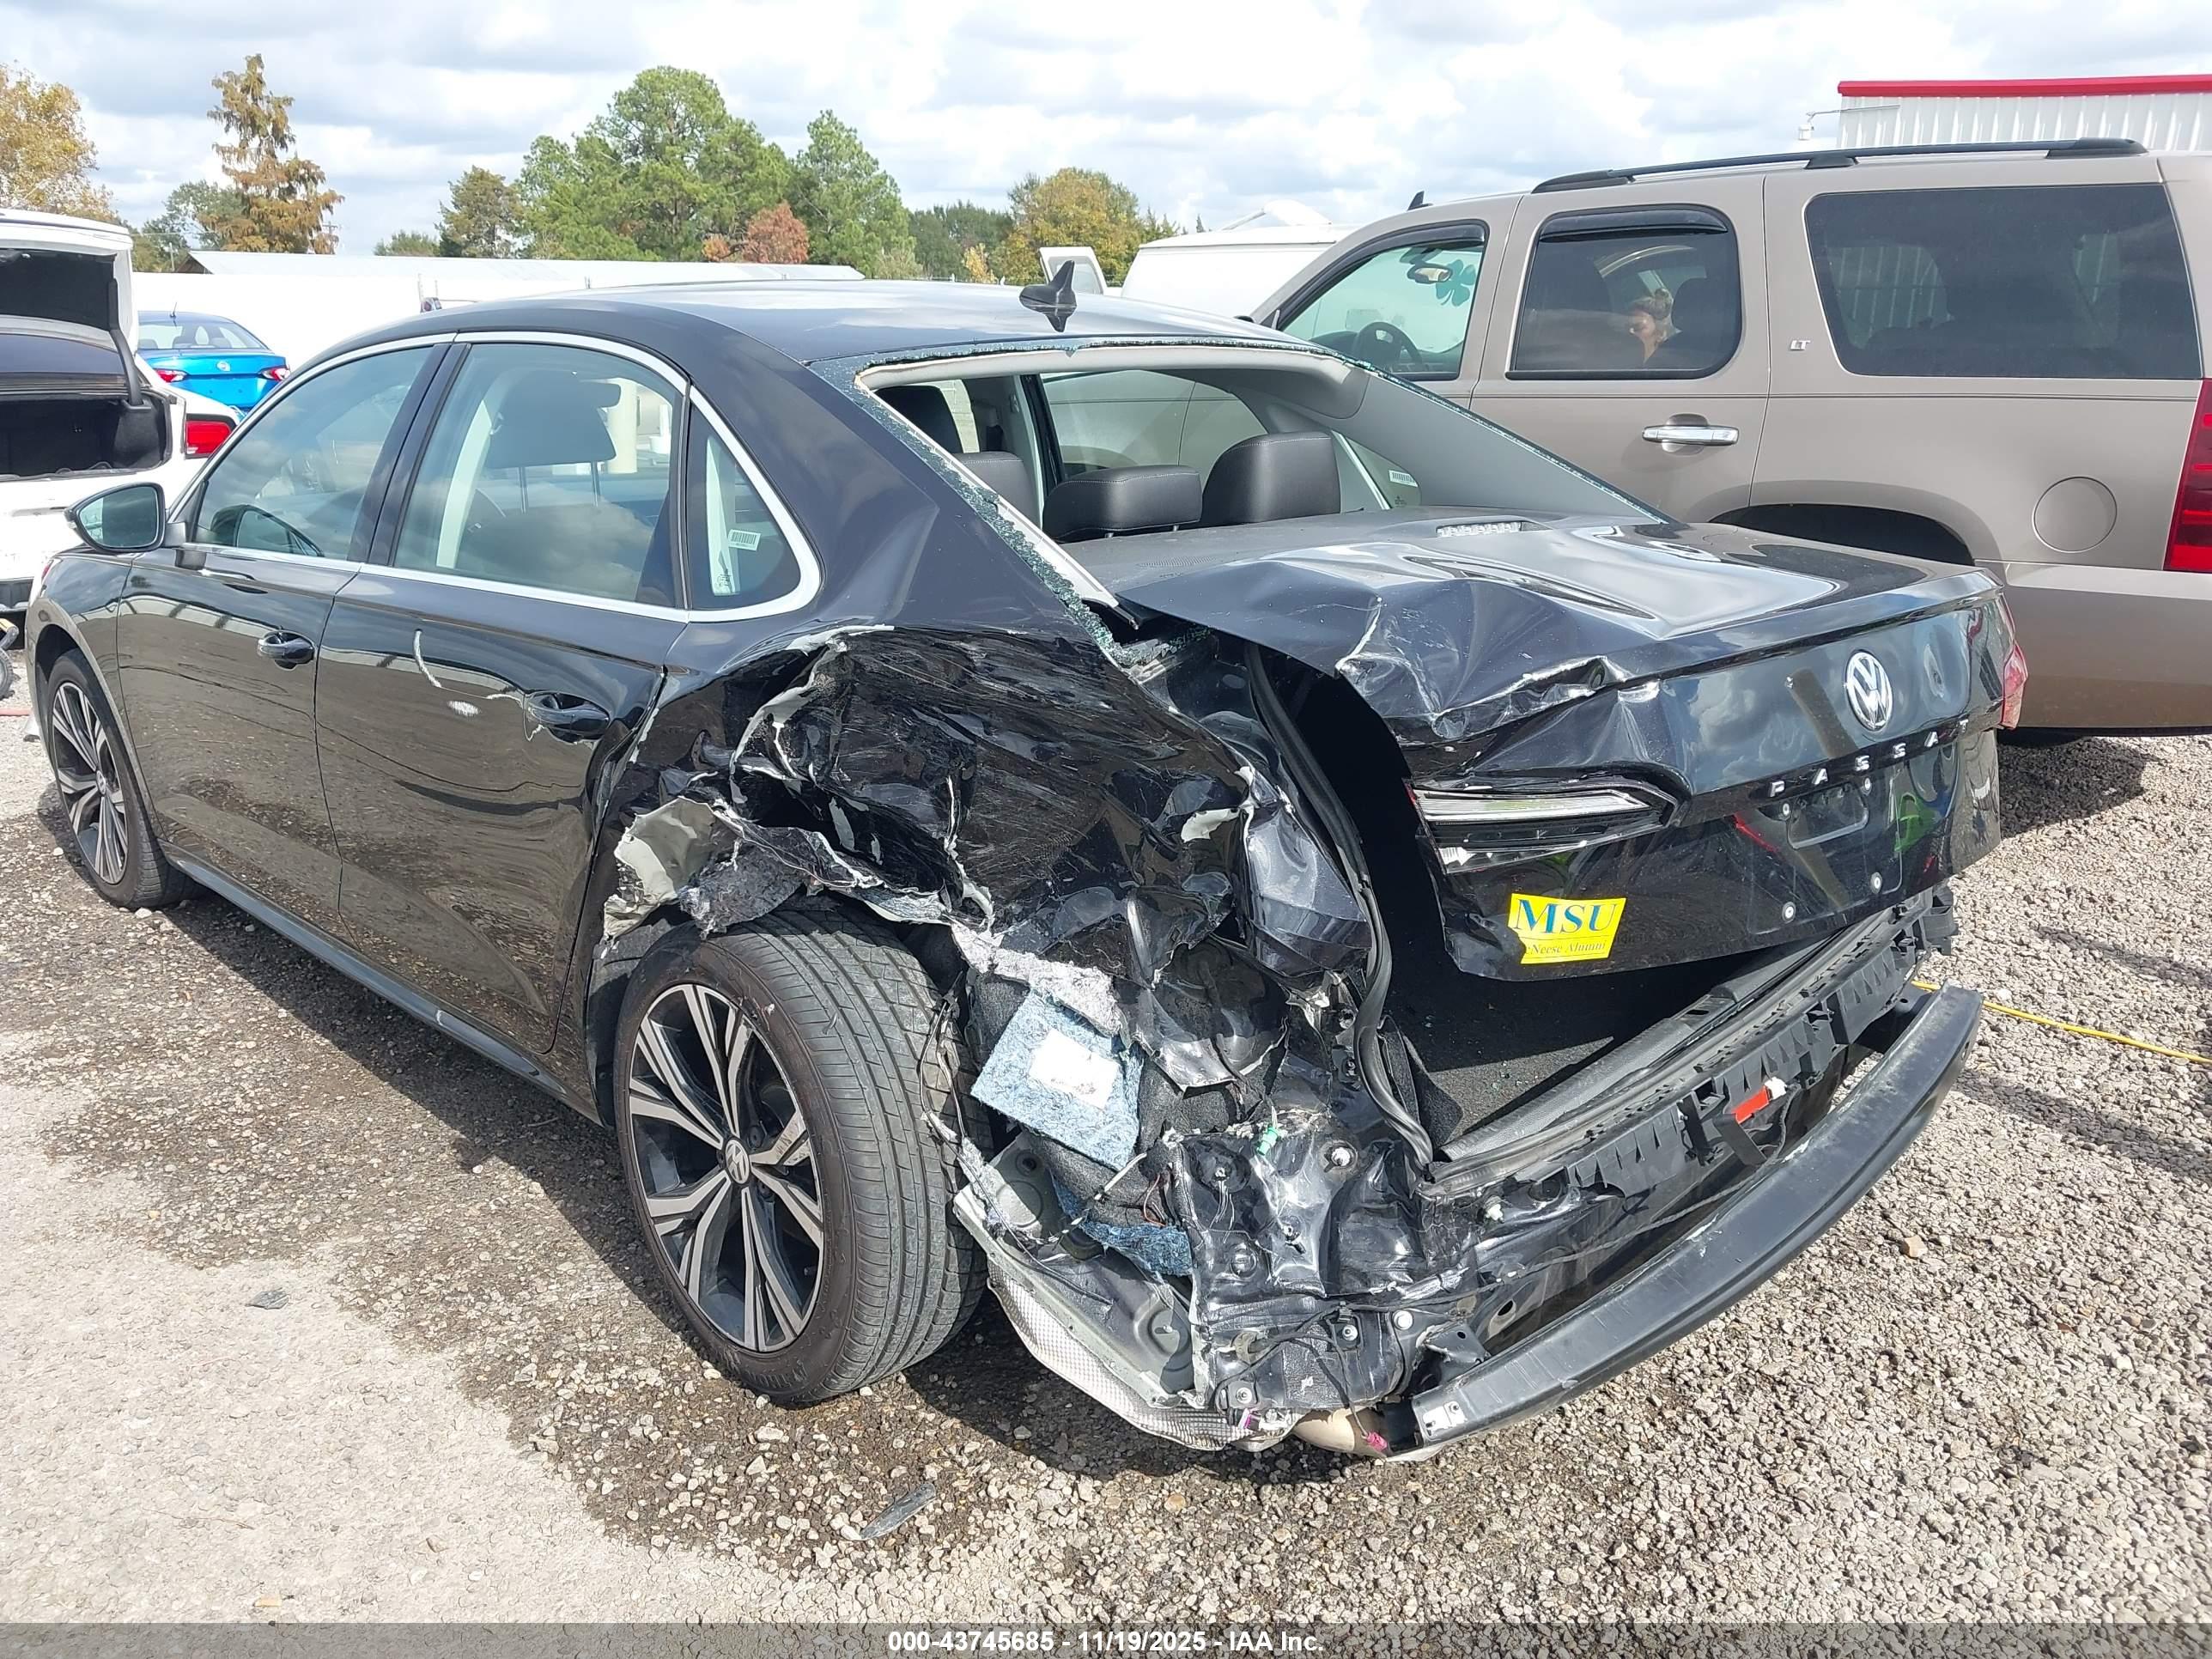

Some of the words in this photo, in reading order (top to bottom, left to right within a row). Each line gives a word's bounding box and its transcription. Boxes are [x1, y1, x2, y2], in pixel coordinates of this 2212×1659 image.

[1790, 340, 1811, 350] LT
[1769, 719, 1968, 797] PASSAT
[1514, 899, 1617, 934] MSU
[1565, 940, 1607, 953] Alumni
